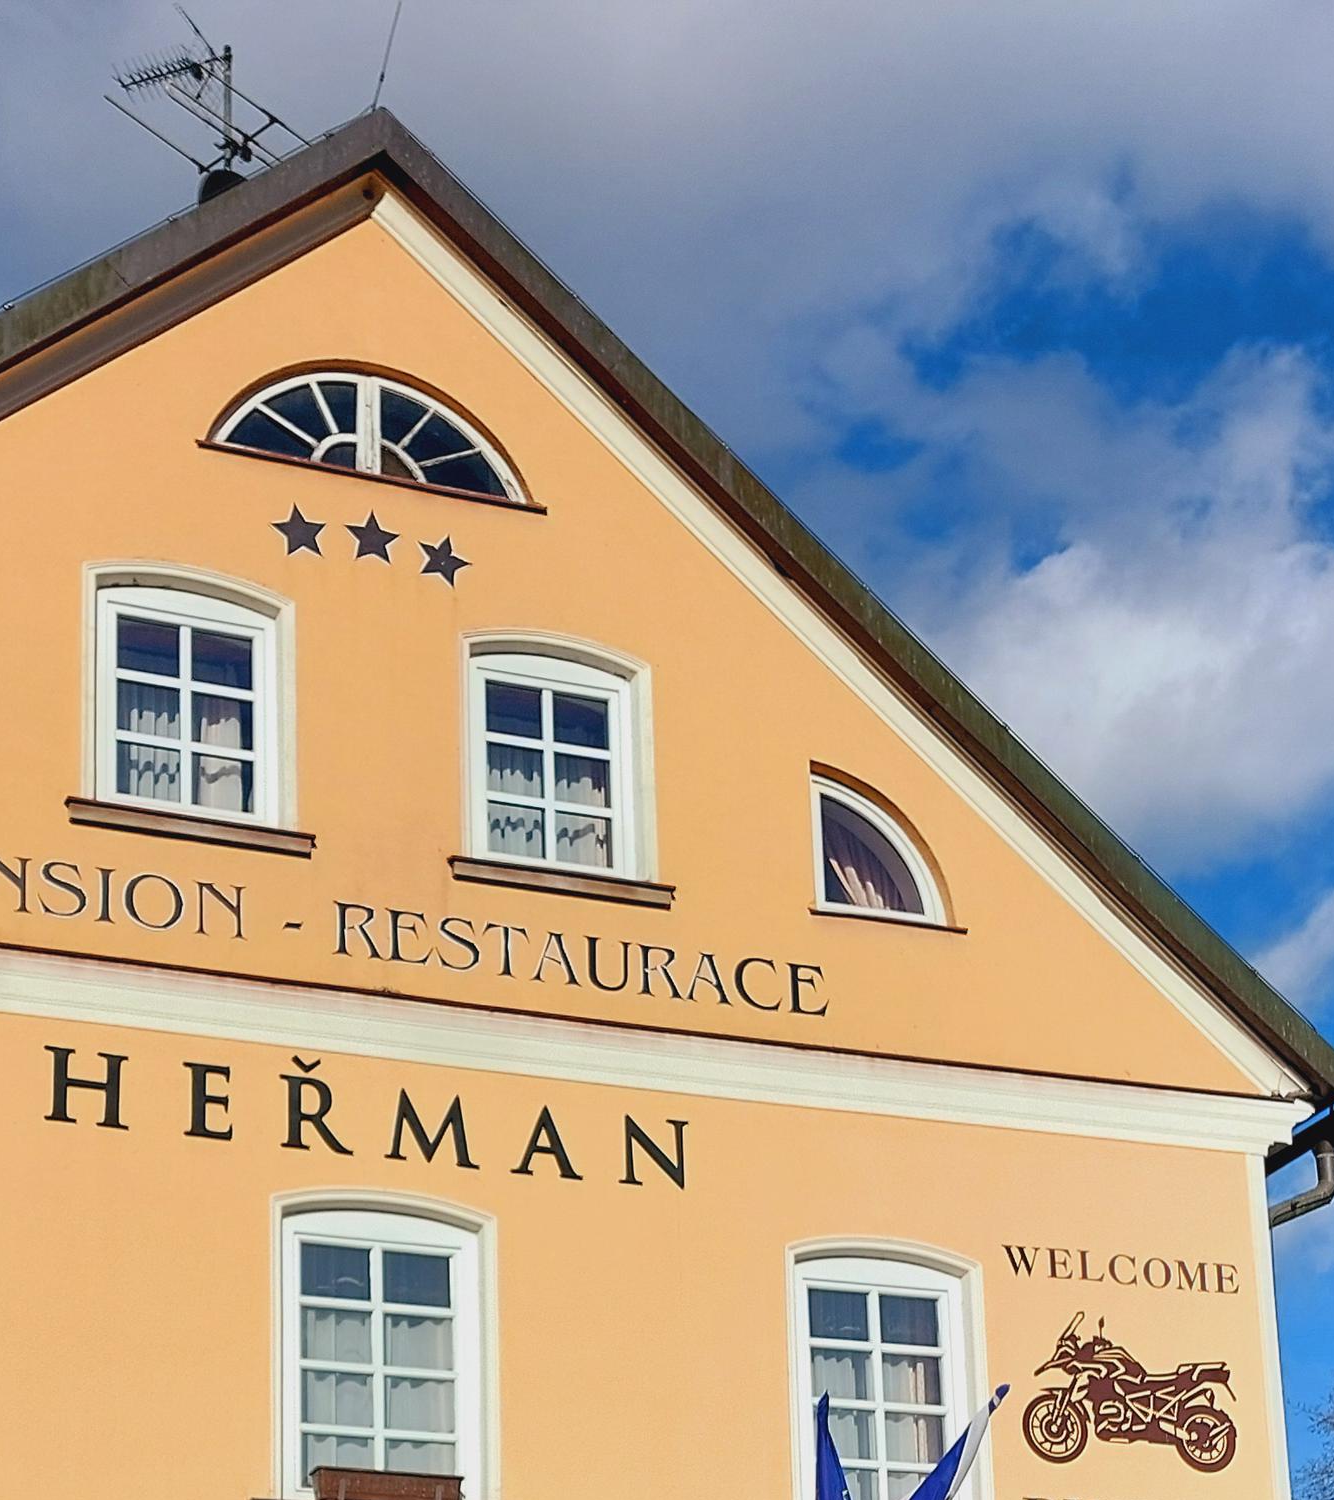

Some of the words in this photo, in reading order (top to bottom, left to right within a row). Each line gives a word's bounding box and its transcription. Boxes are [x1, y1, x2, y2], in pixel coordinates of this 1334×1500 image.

[332, 900, 831, 1018] RESTAURACE
[43, 1043, 689, 1190] HEŘMAN
[1001, 1244, 1240, 1295] WELCOME
